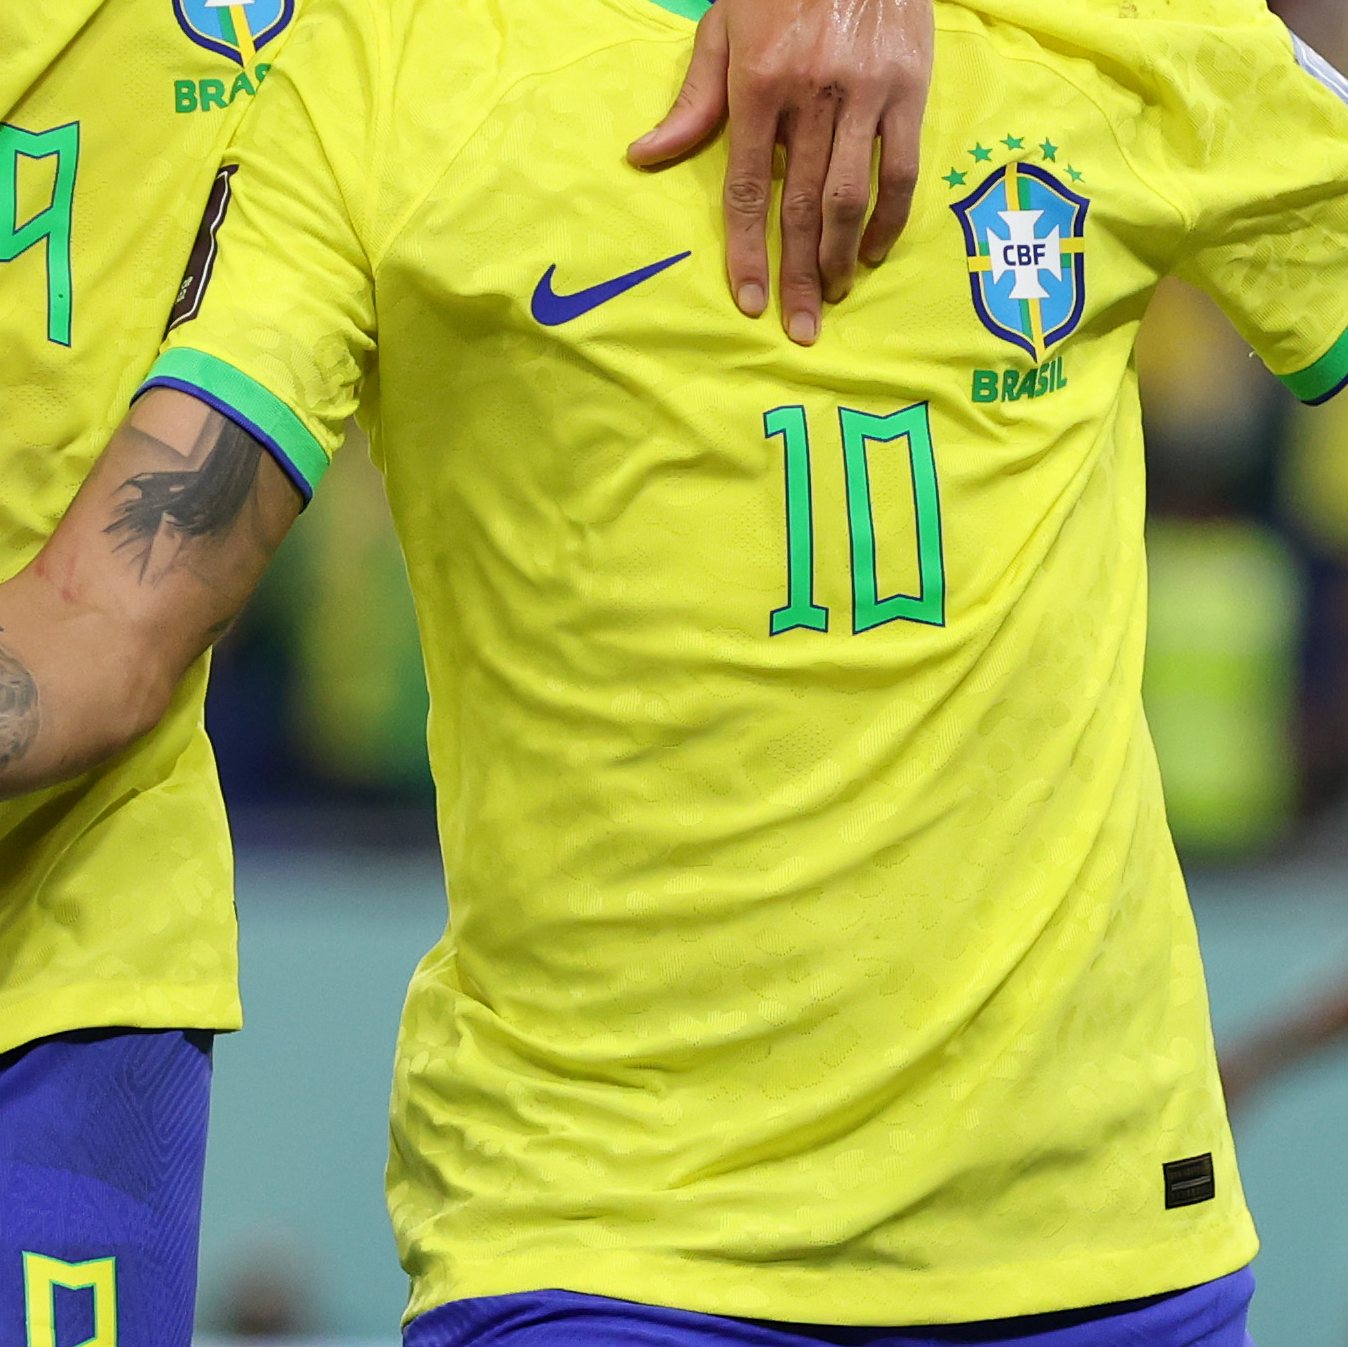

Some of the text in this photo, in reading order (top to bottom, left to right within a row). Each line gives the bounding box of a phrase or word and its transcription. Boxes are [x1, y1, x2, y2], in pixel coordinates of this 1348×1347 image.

[1003, 243, 1045, 266] CBF
[971, 356, 1067, 403] BRASIL
[762, 400, 945, 637] 10
